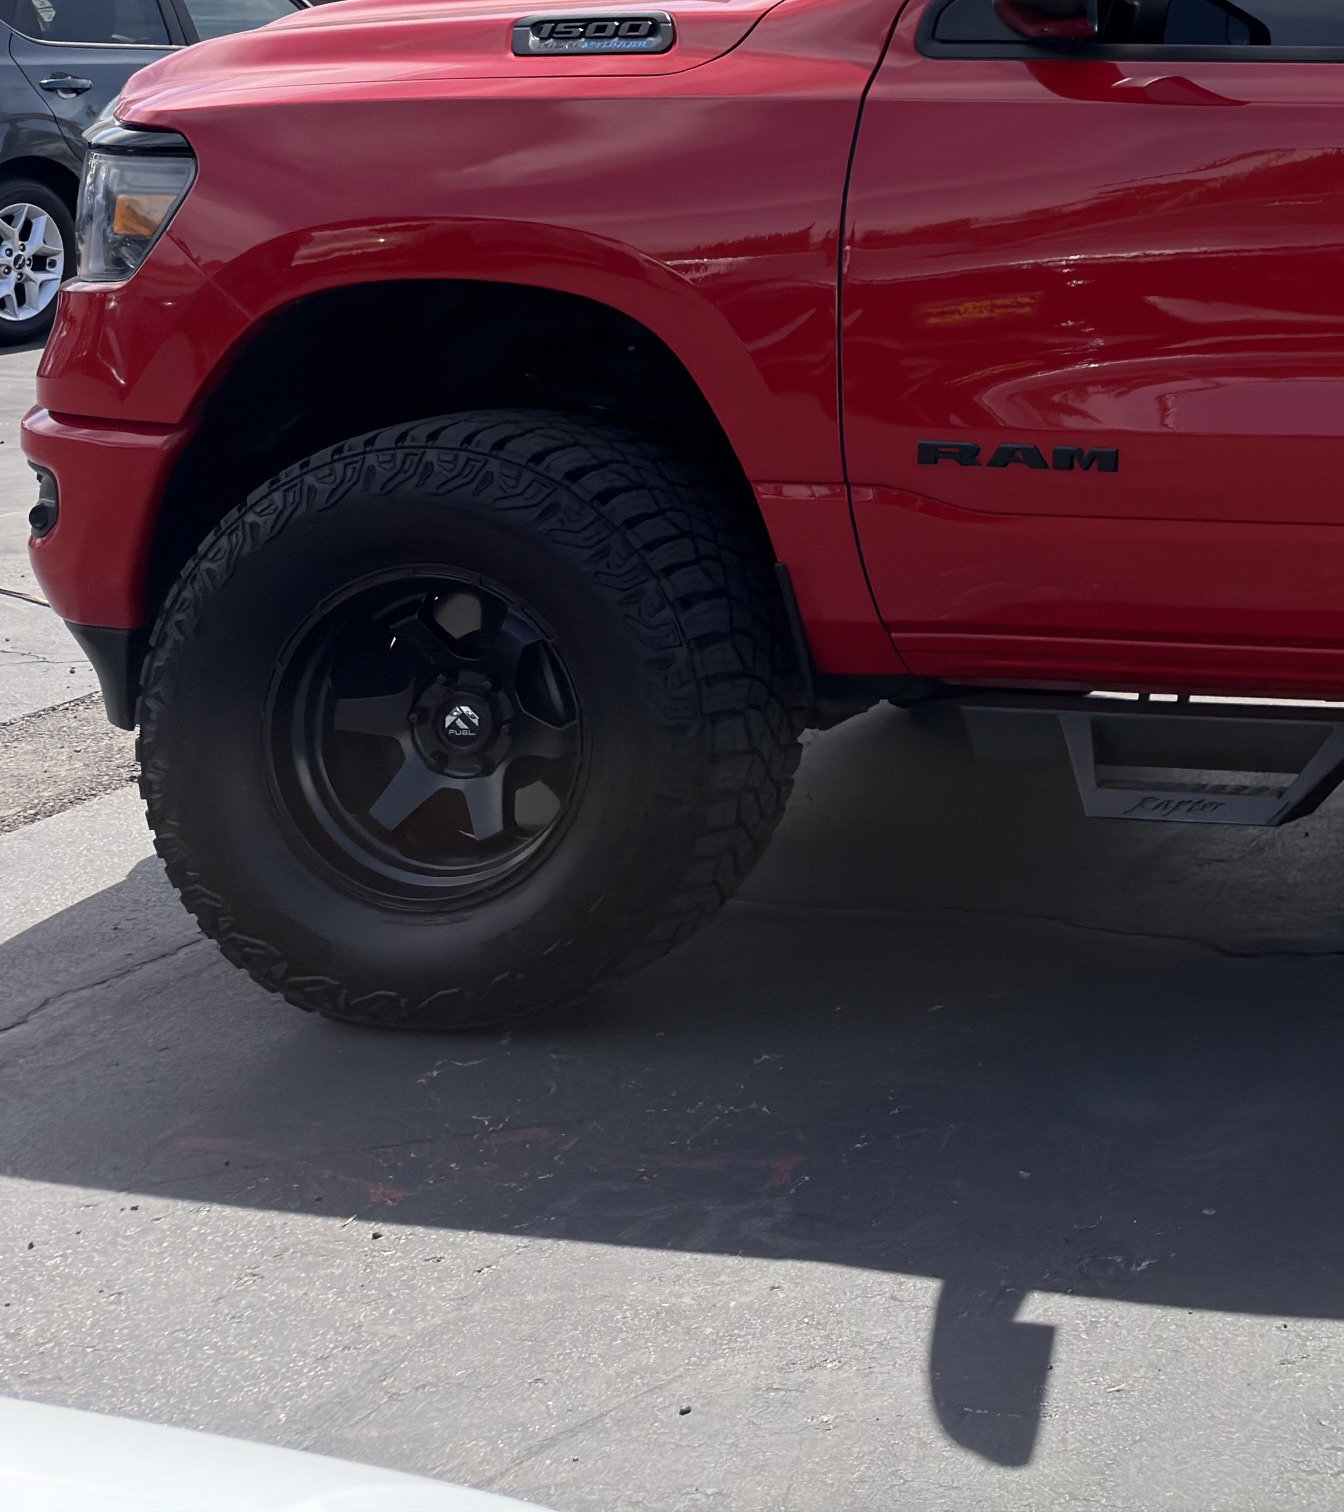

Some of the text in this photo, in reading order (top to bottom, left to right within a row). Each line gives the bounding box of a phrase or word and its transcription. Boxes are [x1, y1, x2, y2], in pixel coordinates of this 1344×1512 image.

[538, 21, 652, 38] 1500
[917, 439, 1120, 473] RAM
[1123, 796, 1226, 818] Raptor
